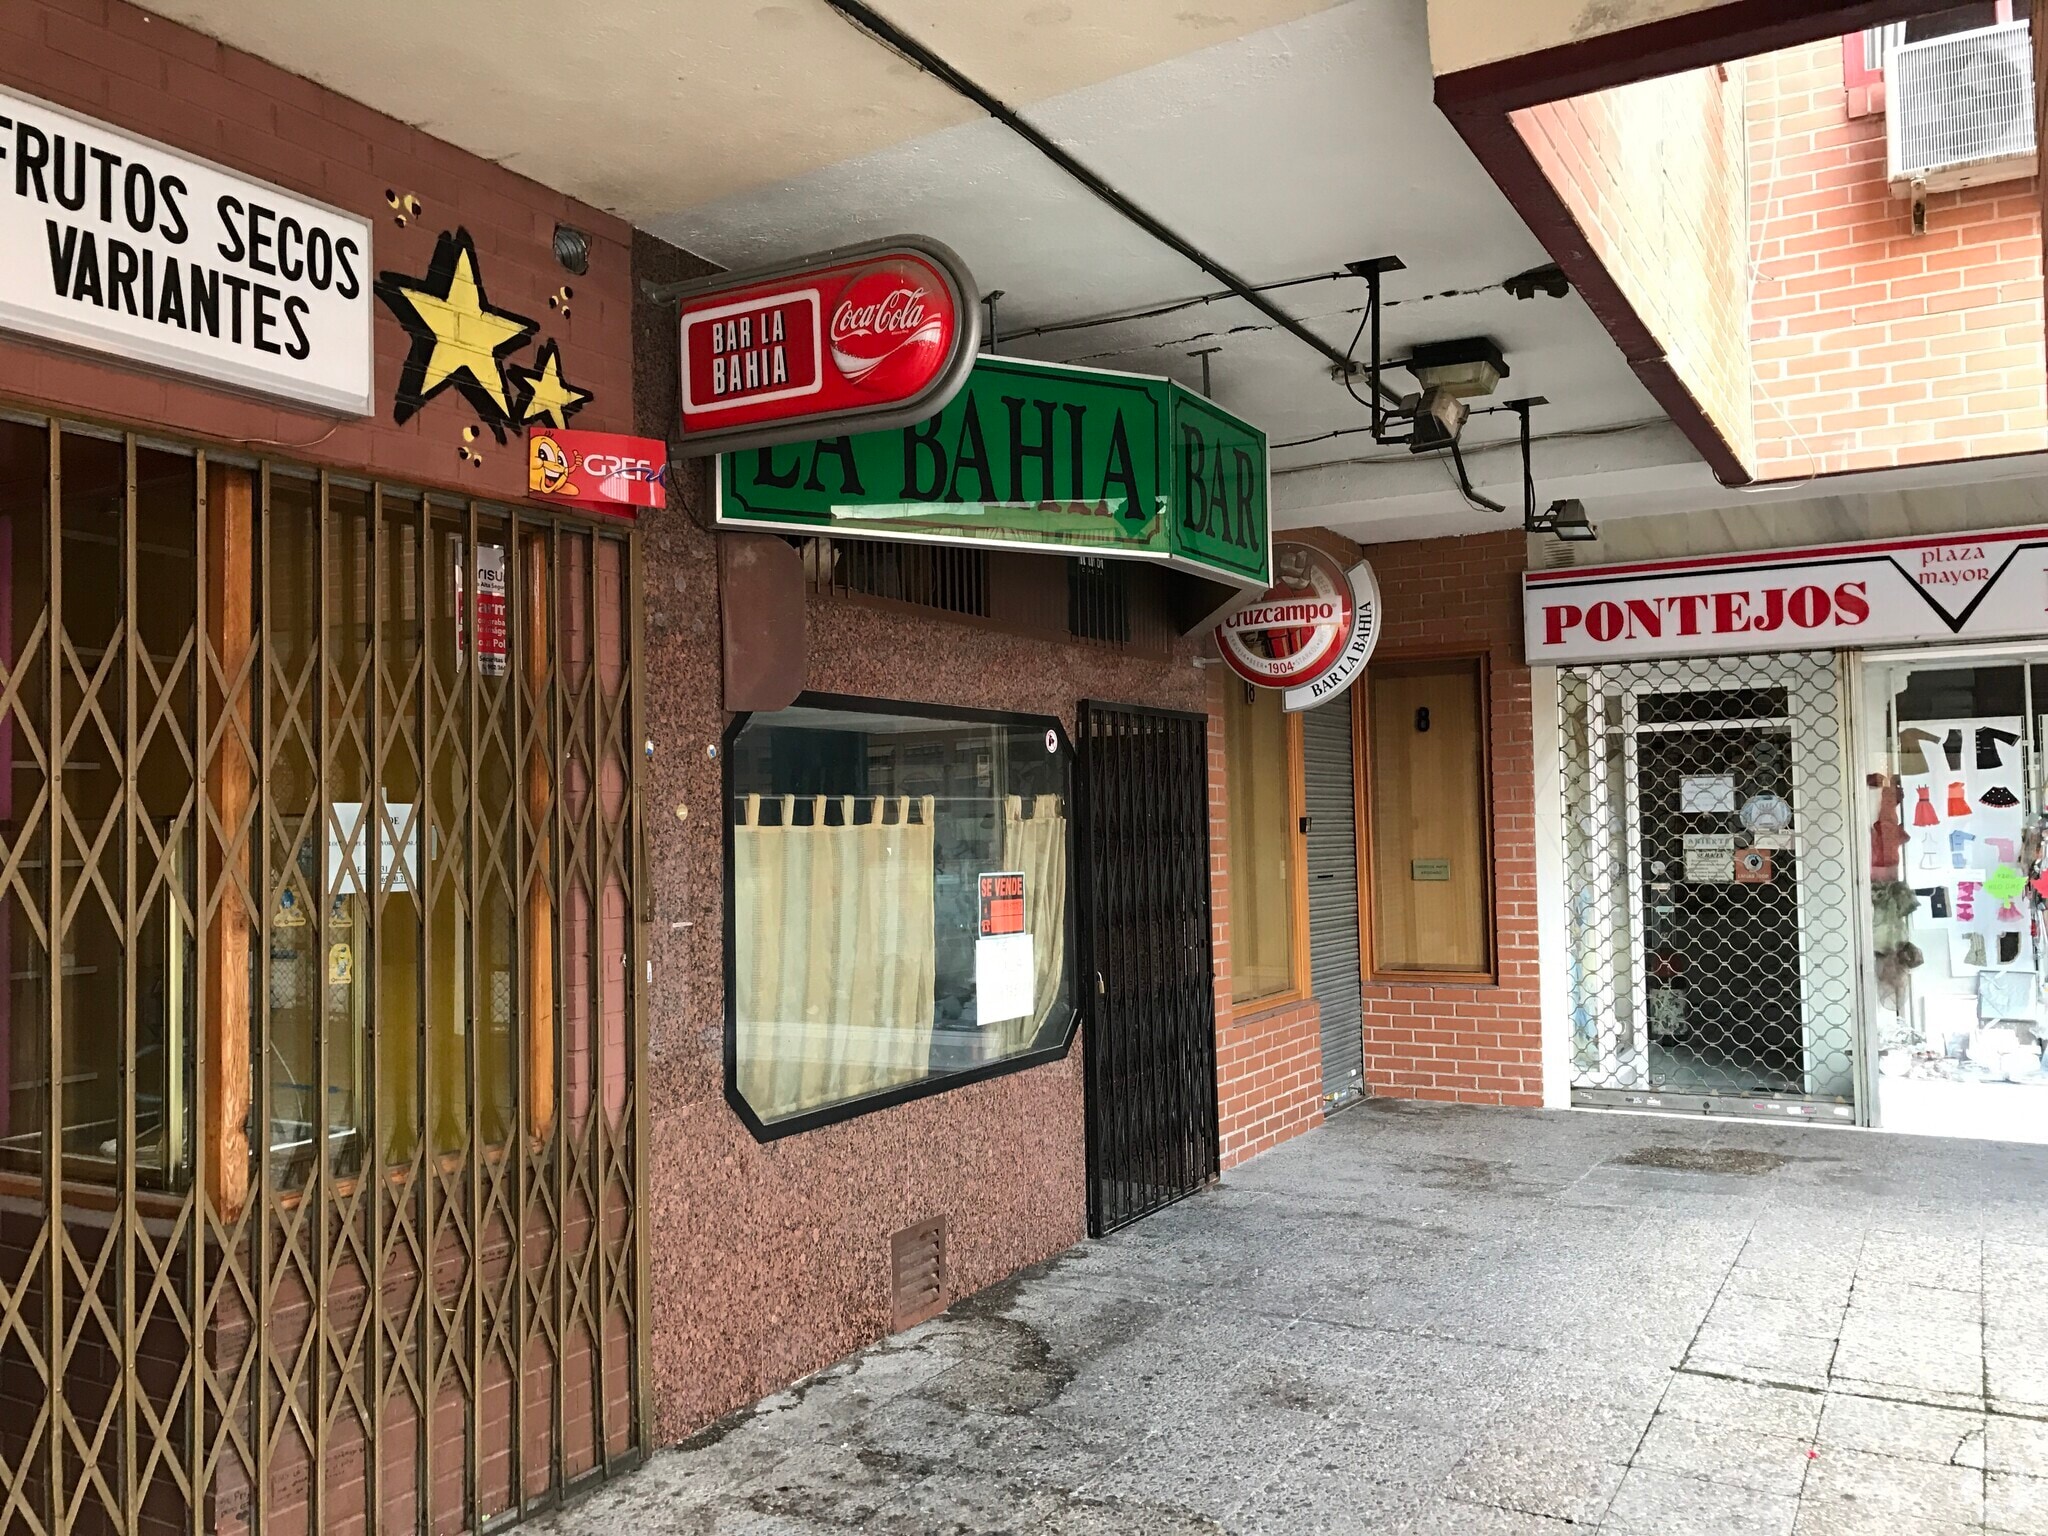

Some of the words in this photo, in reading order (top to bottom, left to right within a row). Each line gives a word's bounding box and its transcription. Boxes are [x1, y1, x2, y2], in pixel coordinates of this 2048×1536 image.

[217, 195, 360, 300] SECOS
[46, 219, 311, 361] VARIANTES
[830, 287, 930, 342] Coca-Cola
[713, 317, 751, 354] BAR
[761, 310, 784, 344] LA
[713, 345, 787, 395] BAHIA
[900, 388, 1147, 521] BAHIA
[1182, 421, 1260, 553] BAR
[1542, 582, 1870, 645] PONTEJOS
[1267, 661, 1295, 674] 1904
[1310, 671, 1342, 697] BAR
[1338, 655, 1360, 677] LA
[1351, 601, 1372, 655] BAHIA
[1416, 706, 1430, 732] 8
[981, 877, 993, 897] SE
[994, 877, 1023, 897] VENDE
